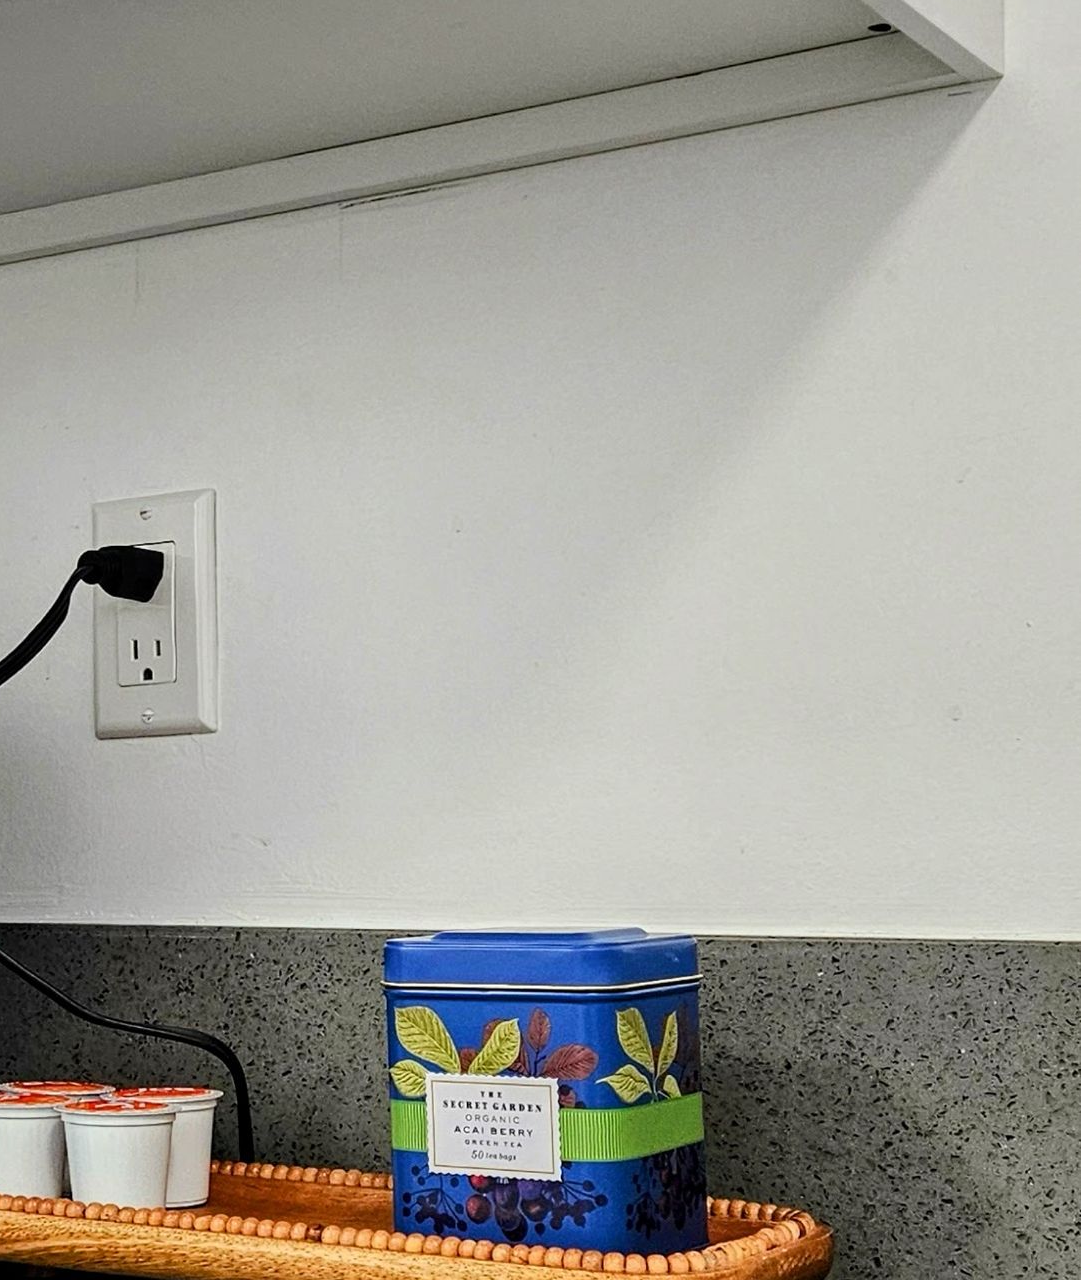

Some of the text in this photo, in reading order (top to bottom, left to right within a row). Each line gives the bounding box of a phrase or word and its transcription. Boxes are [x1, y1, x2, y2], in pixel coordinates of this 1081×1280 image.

[480, 1091, 503, 1099] THE
[442, 1100, 543, 1113] SECRET GARDEN
[465, 1113, 520, 1124] ORGANIC
[454, 1125, 534, 1138] ACAI BERRY
[464, 1139, 499, 1147] GREEN
[471, 1150, 517, 1162] 50 tea bags
